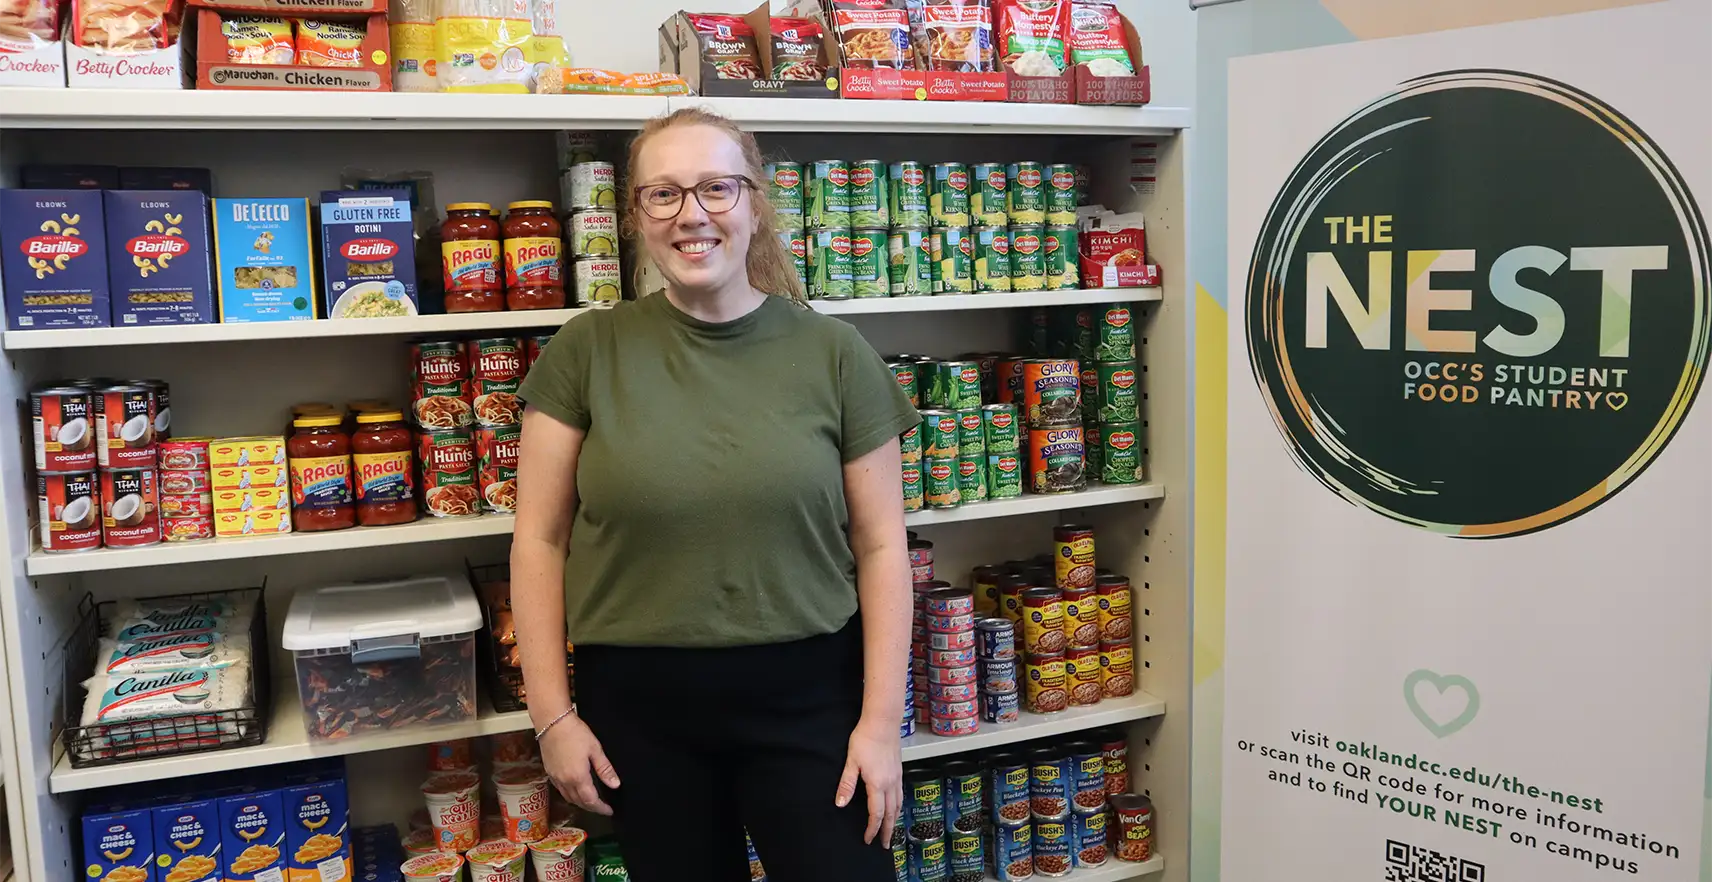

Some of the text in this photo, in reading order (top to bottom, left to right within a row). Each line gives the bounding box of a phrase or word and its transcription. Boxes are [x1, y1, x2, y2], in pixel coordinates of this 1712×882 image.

[1020, 12, 1054, 23] Buttery
[708, 40, 746, 50] BROWN
[776, 42, 812, 52] BROWN
[76, 59, 174, 79] Betty Crocker
[224, 70, 371, 87] Maruchan Chicken Flavor
[851, 75, 872, 85] Betty
[877, 78, 899, 86] Sweet
[935, 77, 955, 87] Betty
[752, 80, 785, 89] GRAVY
[847, 82, 876, 92] Crocker
[960, 80, 982, 88] Sweet
[930, 85, 958, 95] Crocker
[1010, 90, 1069, 100] POTATOES
[1086, 90, 1144, 100] POTATOES
[232, 203, 290, 222] DE CECCO
[333, 208, 401, 221] GLUTEN FREE
[583, 216, 613, 224] HERDEZ
[354, 224, 381, 233] ROTINI
[1324, 215, 1393, 244] THE
[1091, 237, 1133, 245] KIMCHI
[29, 241, 80, 254] Barilla
[133, 240, 182, 253] Barilla
[347, 243, 391, 256] Barilla
[591, 264, 619, 272] HERDEZ
[1305, 245, 1669, 358] NEST
[421, 359, 461, 374] Hunt's
[480, 357, 520, 372] Hunt's
[1041, 363, 1074, 376] GLORY
[1404, 361, 1628, 388] OCC'S STUDENT
[486, 383, 517, 391] Traditional
[1038, 377, 1078, 388] SEASONED
[427, 386, 458, 394] Traditional
[1404, 383, 1602, 410] FOOD PANTRY
[63, 404, 86, 413] THAI
[125, 401, 147, 410] THAI
[1047, 430, 1080, 443] GLORY
[118, 449, 147, 458] coconut
[1044, 443, 1083, 455] SEASONED
[55, 453, 86, 462] coconut
[434, 448, 473, 463] Hunt's
[441, 475, 471, 483] Traditional
[67, 483, 90, 492] THAI
[115, 481, 140, 490] THAI
[59, 532, 91, 541] coconut
[110, 526, 154, 537] coconut milk
[986, 662, 1013, 670] ARMOUR
[114, 669, 196, 697] Canilla
[1033, 767, 1059, 777] BUSH'S
[1291, 728, 1604, 814] visit oaklandcc.edu/the-nest
[915, 787, 940, 799] BUSH'S
[1237, 738, 1681, 859] or scan the QR code for more information
[450, 801, 474, 816] CUP
[912, 806, 930, 814] Black
[237, 811, 265, 822] mac &
[1119, 814, 1134, 824] Van
[1268, 766, 1639, 876] and to find YOUR NEST on campus
[1038, 825, 1064, 835] BUSH'S
[1127, 829, 1150, 840] BEANS
[954, 839, 979, 851] BUSH'S
[554, 859, 577, 873] CUP
